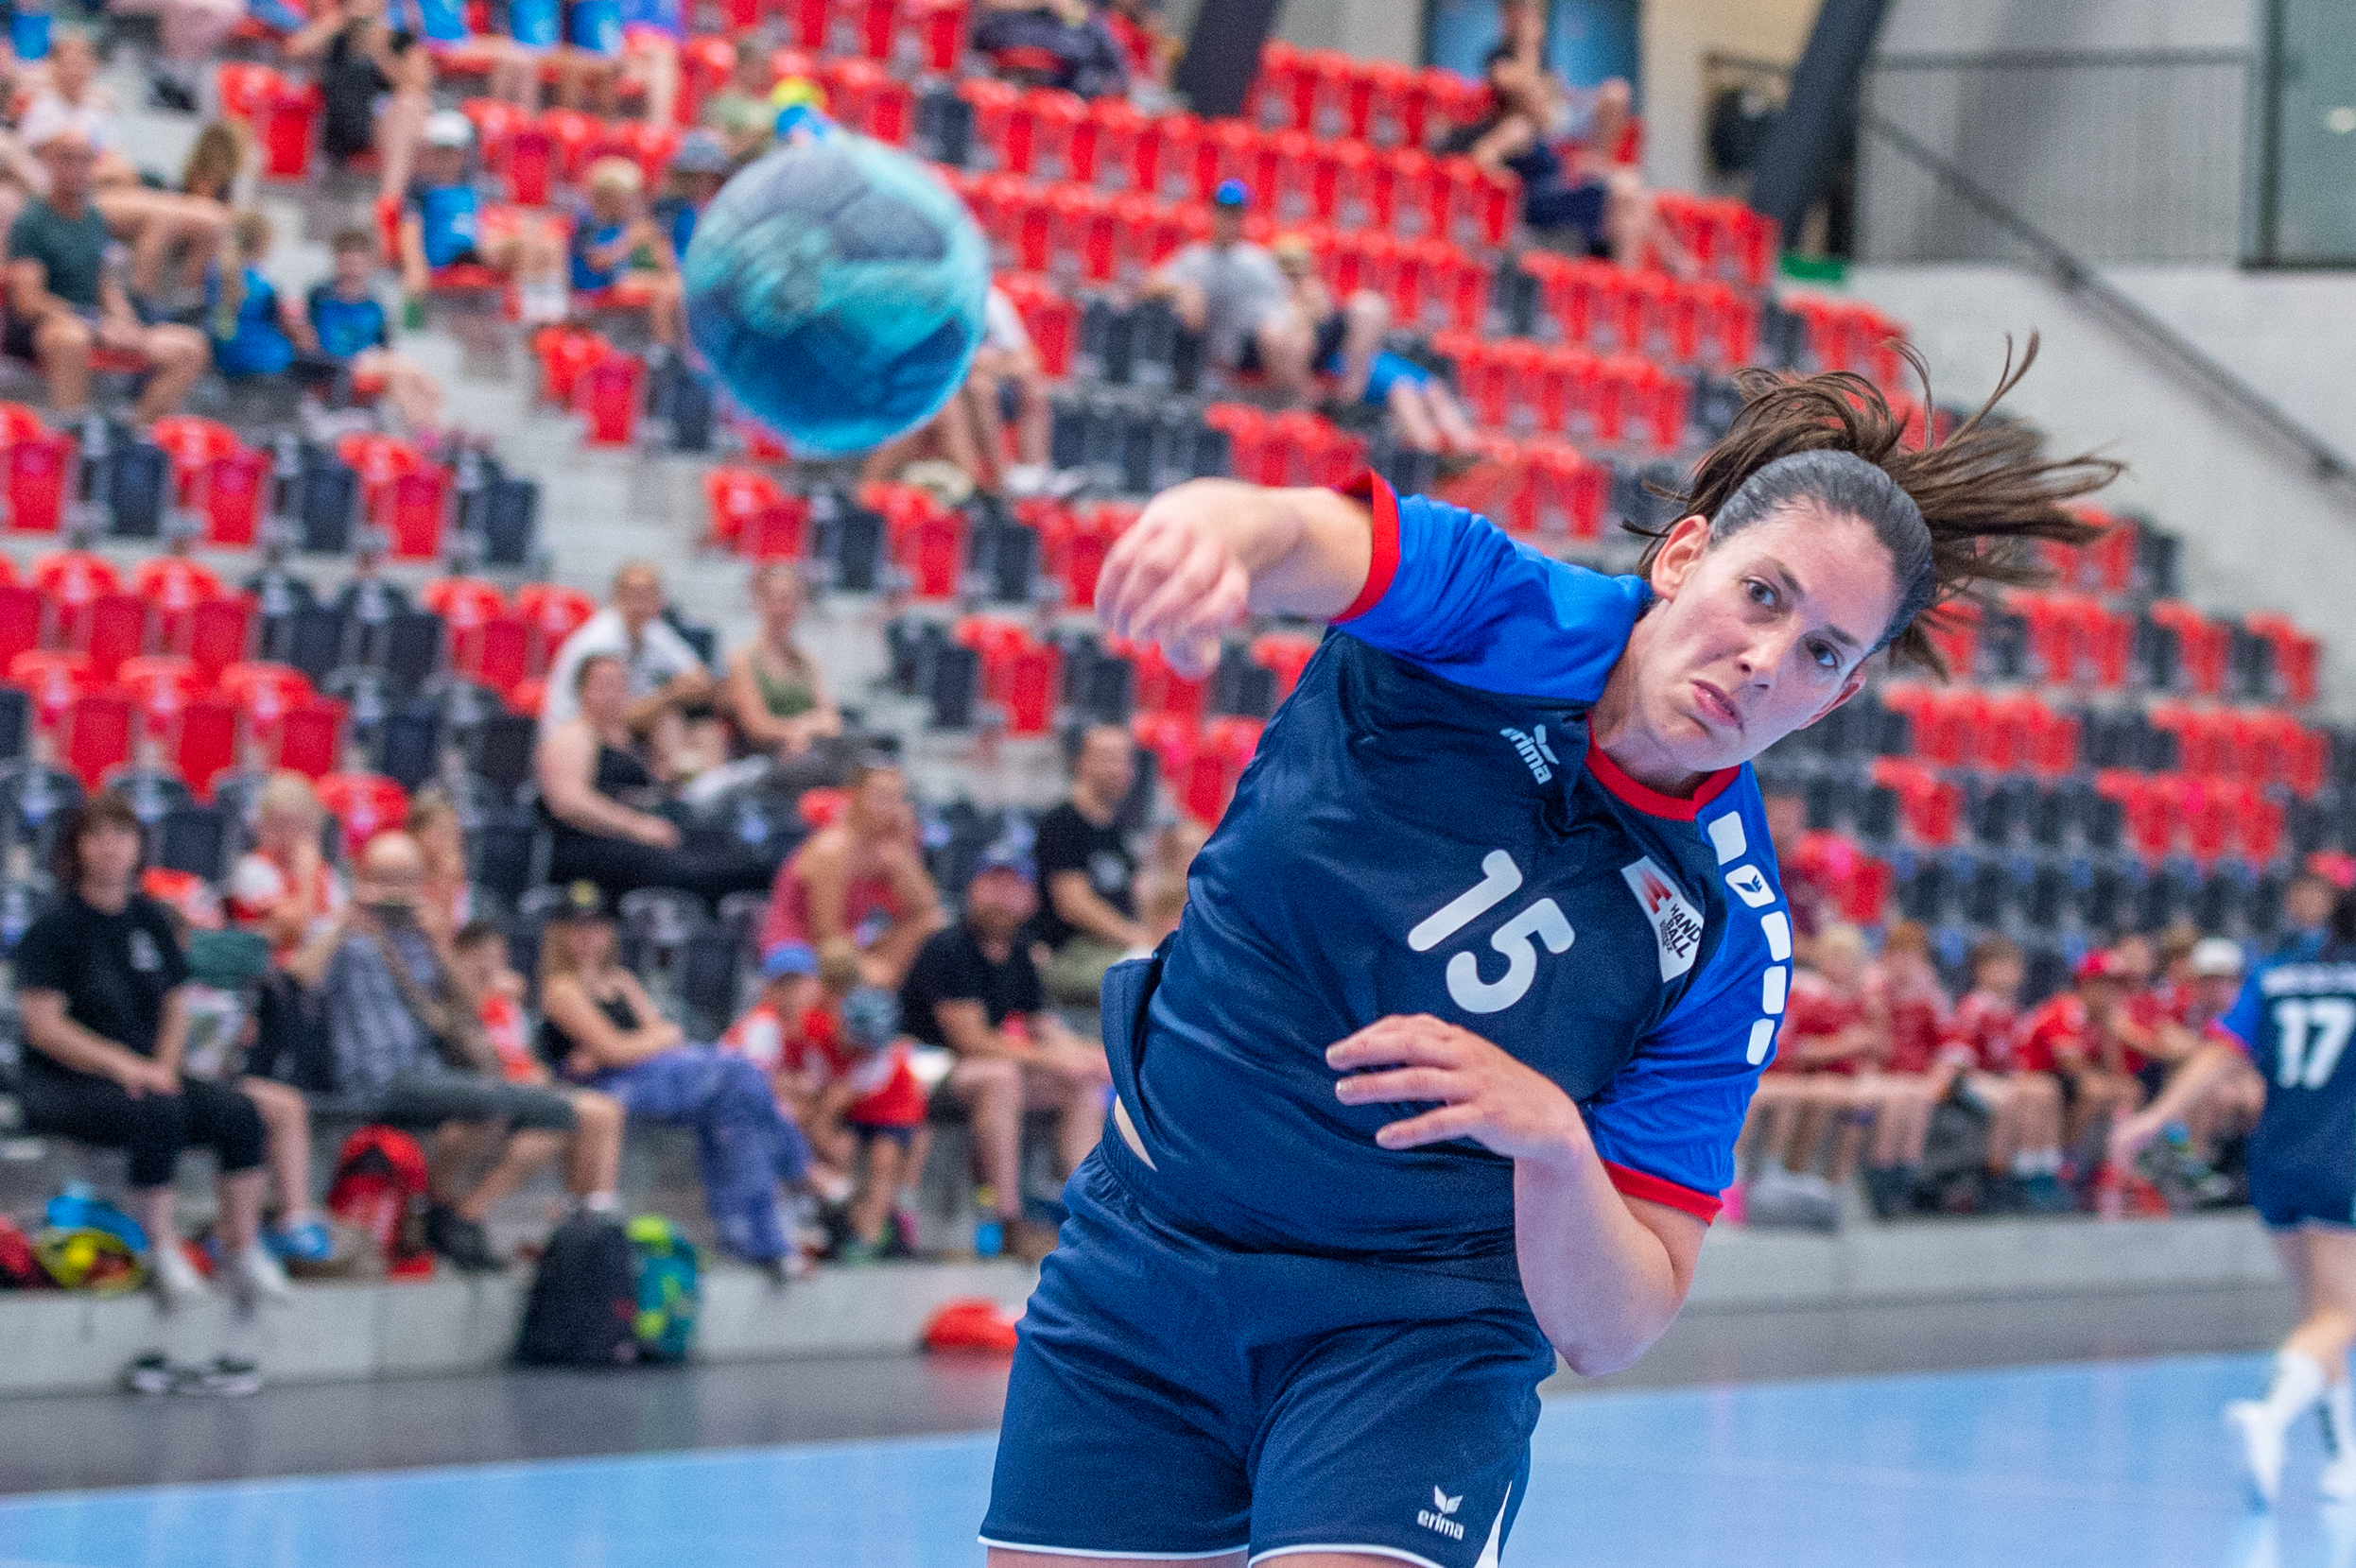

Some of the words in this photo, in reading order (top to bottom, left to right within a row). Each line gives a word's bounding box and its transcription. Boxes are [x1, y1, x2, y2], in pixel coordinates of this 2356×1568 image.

[1408, 849, 1576, 1013] 15
[1667, 918, 1691, 959] BALL
[1671, 903, 1702, 943] HAND
[2272, 996, 2356, 1089] 17
[1416, 1508, 1465, 1542] erima
